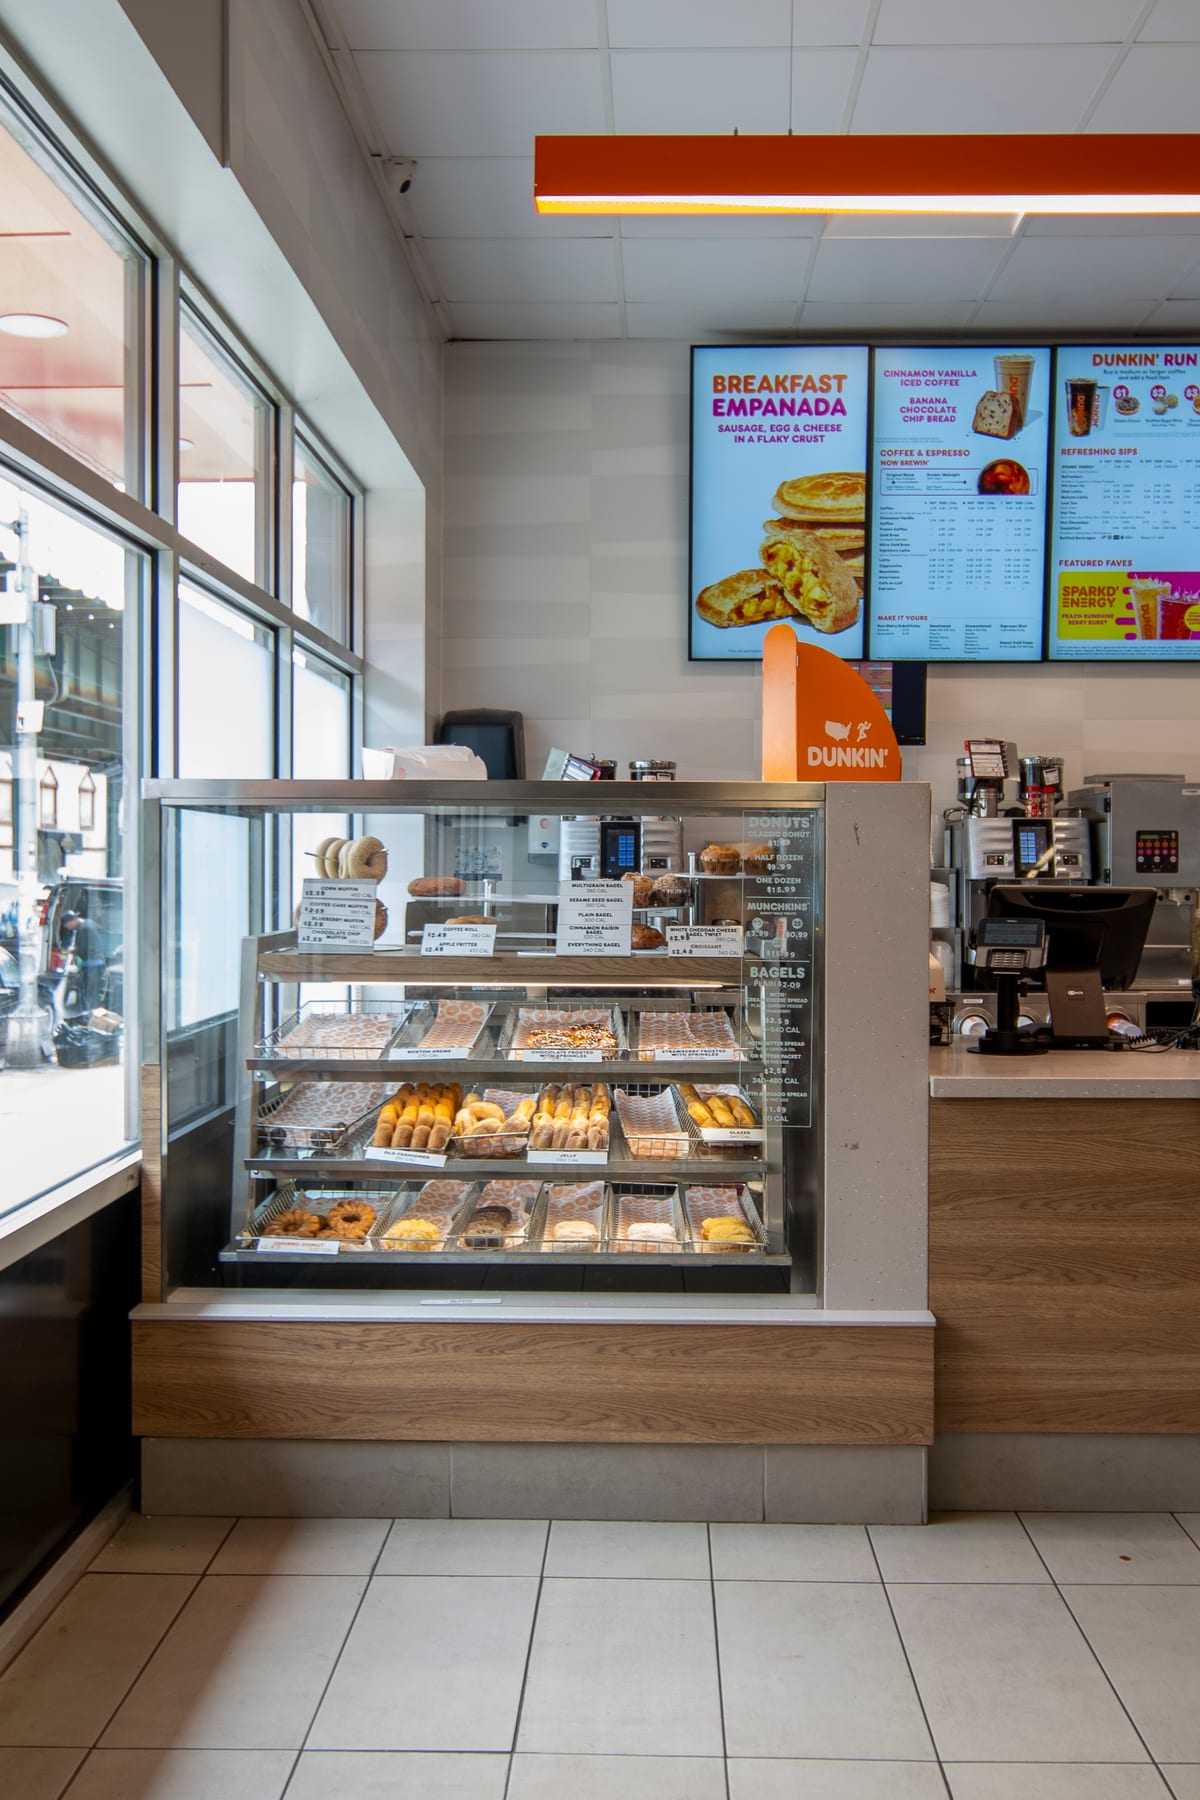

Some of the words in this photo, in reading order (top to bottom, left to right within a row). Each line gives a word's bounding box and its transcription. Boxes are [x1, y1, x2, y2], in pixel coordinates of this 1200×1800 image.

[1092, 353, 1159, 367] DUNKIN'
[1164, 353, 1198, 367] RUN
[883, 370, 935, 378] CINNAMON
[937, 369, 977, 377] VANILLA
[713, 374, 848, 394] BREAKFAST
[900, 379, 922, 387] ICED
[1115, 388, 1126, 397] $1
[909, 397, 947, 405] BANANA
[712, 398, 847, 417] EMPANADA
[900, 406, 957, 414] CHOCOLATE
[902, 415, 925, 423] CHIP
[927, 415, 957, 423] BREAD
[718, 424, 767, 433] SAUSAGE,
[769, 424, 790, 432] EGG
[793, 424, 800, 432] &
[803, 424, 842, 432] CHEESE
[734, 435, 745, 443] IN
[747, 435, 755, 443] A
[757, 435, 789, 443] FLAKY
[792, 435, 825, 443] CRUST
[880, 449, 914, 457] COFFEE
[917, 449, 923, 457] &
[925, 449, 970, 457] ESPRESSO
[1061, 448, 1116, 456] REFRESHING
[1118, 448, 1138, 456] SIPS
[1062, 586, 1119, 597] SPARKD'
[1062, 598, 1116, 608] ENERGY
[807, 746, 889, 768] DUNKIN'
[749, 817, 810, 828] DONUTS
[749, 966, 806, 979] BAGELS
[785, 1026, 801, 1034] CAL
[784, 1077, 800, 1085] CAL
